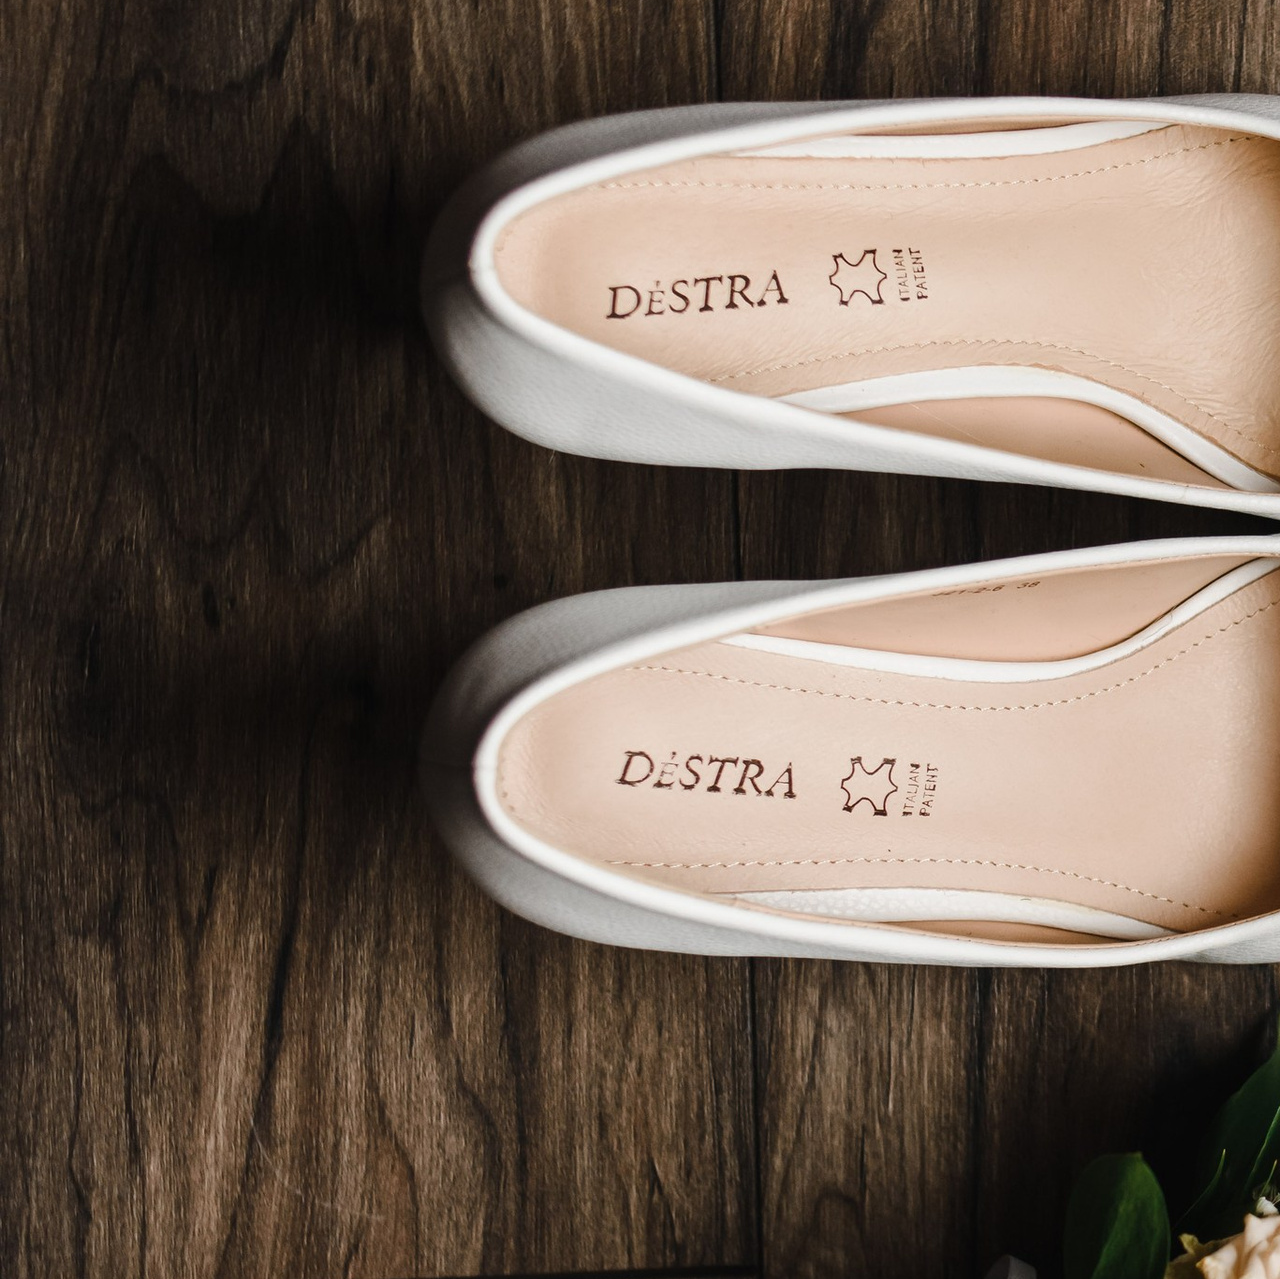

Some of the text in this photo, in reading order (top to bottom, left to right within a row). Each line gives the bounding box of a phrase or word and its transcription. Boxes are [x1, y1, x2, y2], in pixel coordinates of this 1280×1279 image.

[892, 249, 910, 301] ITALIAN
[908, 247, 928, 300] PATENT
[901, 763, 921, 817] ITALIAN
[919, 763, 939, 817] PATENT
